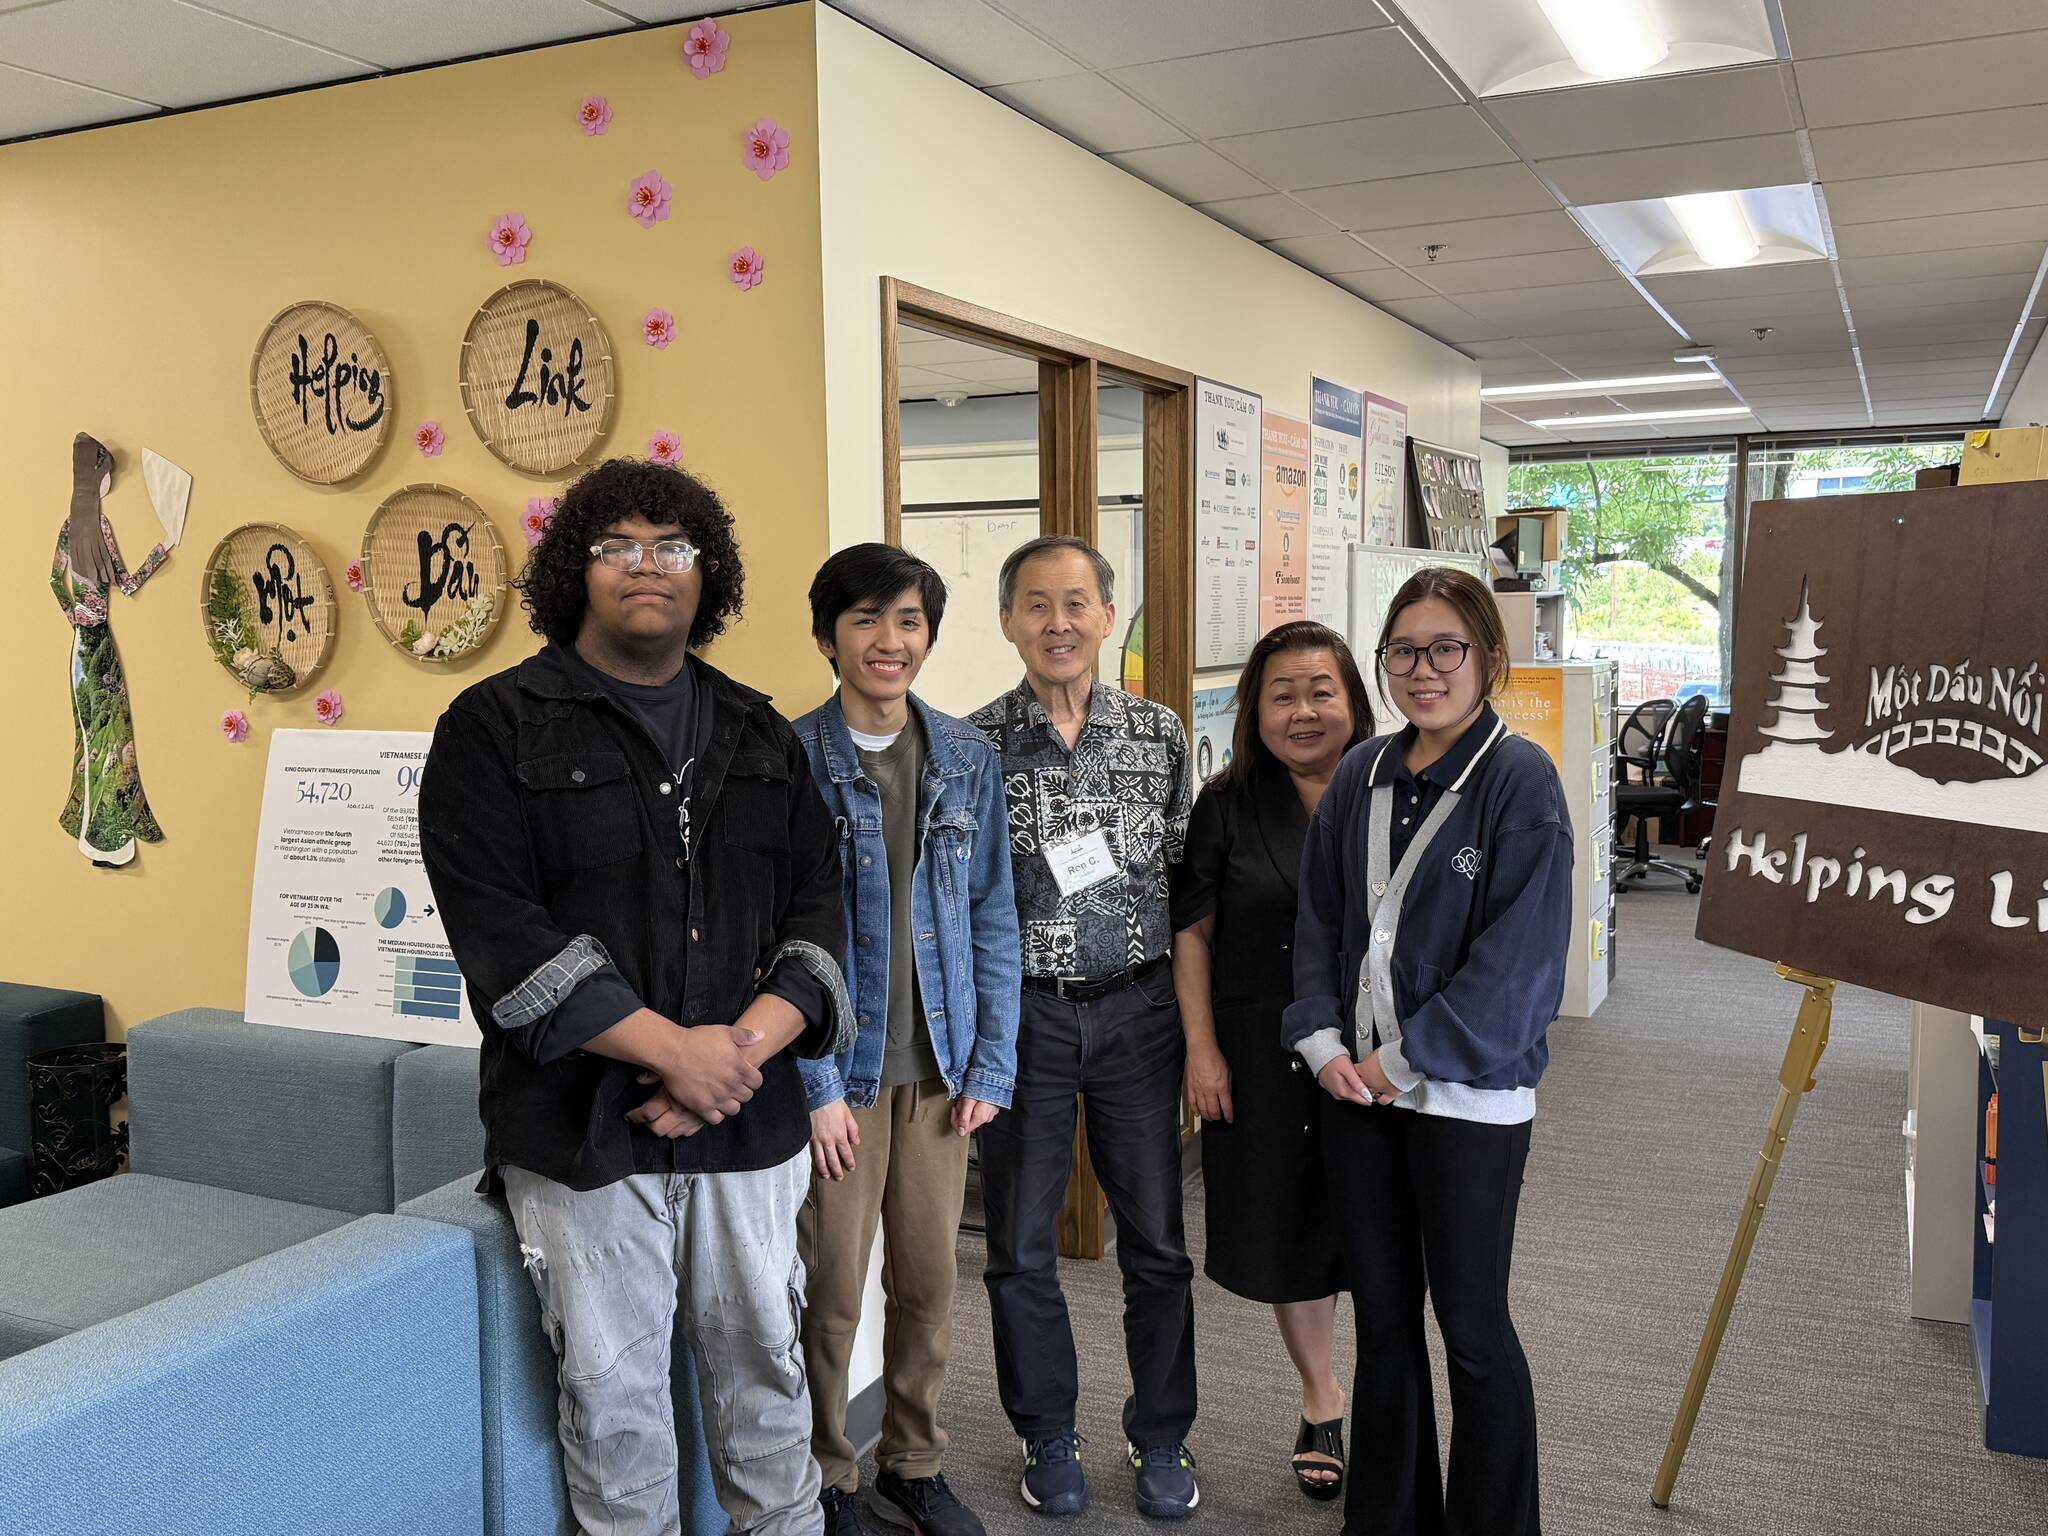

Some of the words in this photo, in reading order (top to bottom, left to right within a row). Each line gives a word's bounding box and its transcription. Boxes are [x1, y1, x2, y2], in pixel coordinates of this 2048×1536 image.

[505, 318, 593, 418] Link
[289, 332, 385, 435] Helping
[1275, 464, 1307, 488] amazon
[1374, 462, 1397, 478] FILSON
[1530, 696, 1551, 709] the
[1864, 663, 1922, 728] Một
[1926, 657, 1983, 705] Dấu
[1986, 660, 2046, 737] Nối
[380, 751, 423, 759] VIETNAMESE
[296, 781, 352, 804] 54,720
[280, 836, 300, 844] largest
[283, 828, 314, 836] Vietnamese
[335, 830, 353, 838] fourth
[280, 845, 311, 853] Washington
[318, 856, 346, 864] statewide
[1067, 861, 1088, 875] Ron
[1088, 856, 1100, 866] C.
[1724, 826, 1956, 925] Helping
[377, 946, 407, 954] VIETNAMESE
[407, 949, 439, 957] HOUSEHOLDS
[407, 941, 436, 949] HOUSEHOLD
